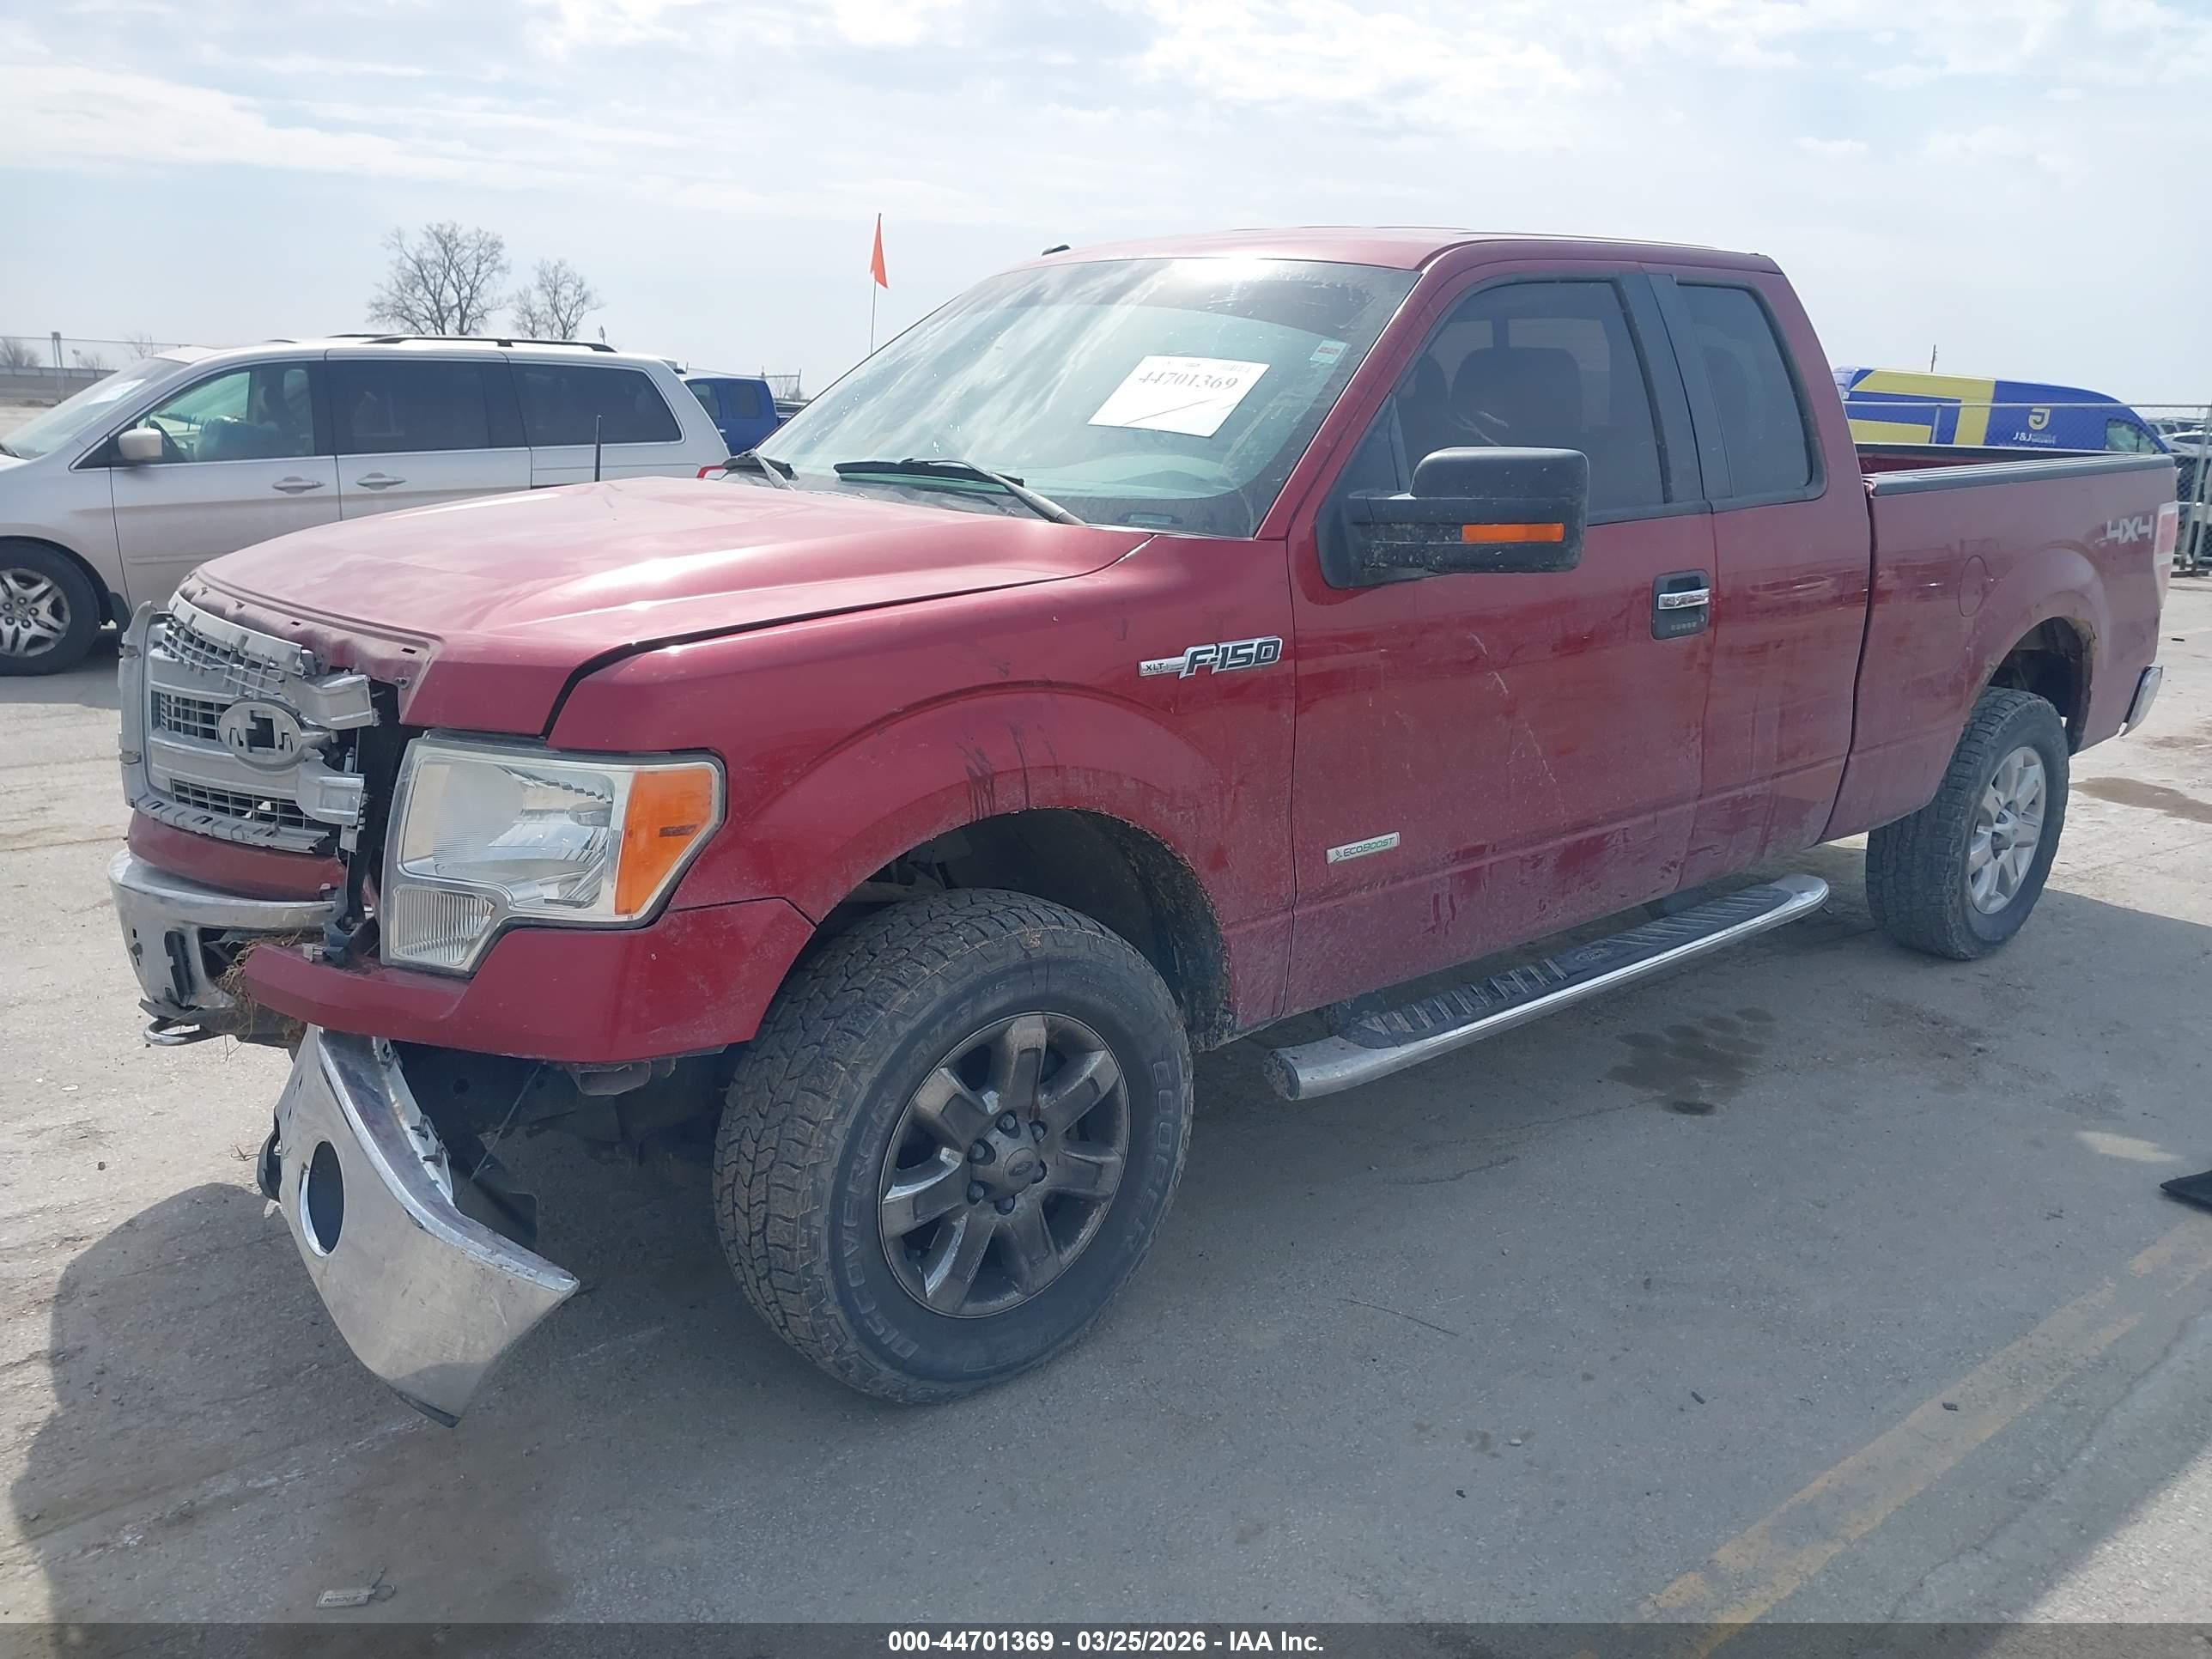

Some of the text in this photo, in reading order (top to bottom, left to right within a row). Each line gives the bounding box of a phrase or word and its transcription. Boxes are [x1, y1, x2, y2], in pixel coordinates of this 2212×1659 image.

[1139, 371, 1239, 391] 44701369
[2012, 431, 2033, 442] J&J
[1146, 638, 1281, 677] XLT F-150
[1343, 836, 1395, 857] ECOBOOST
